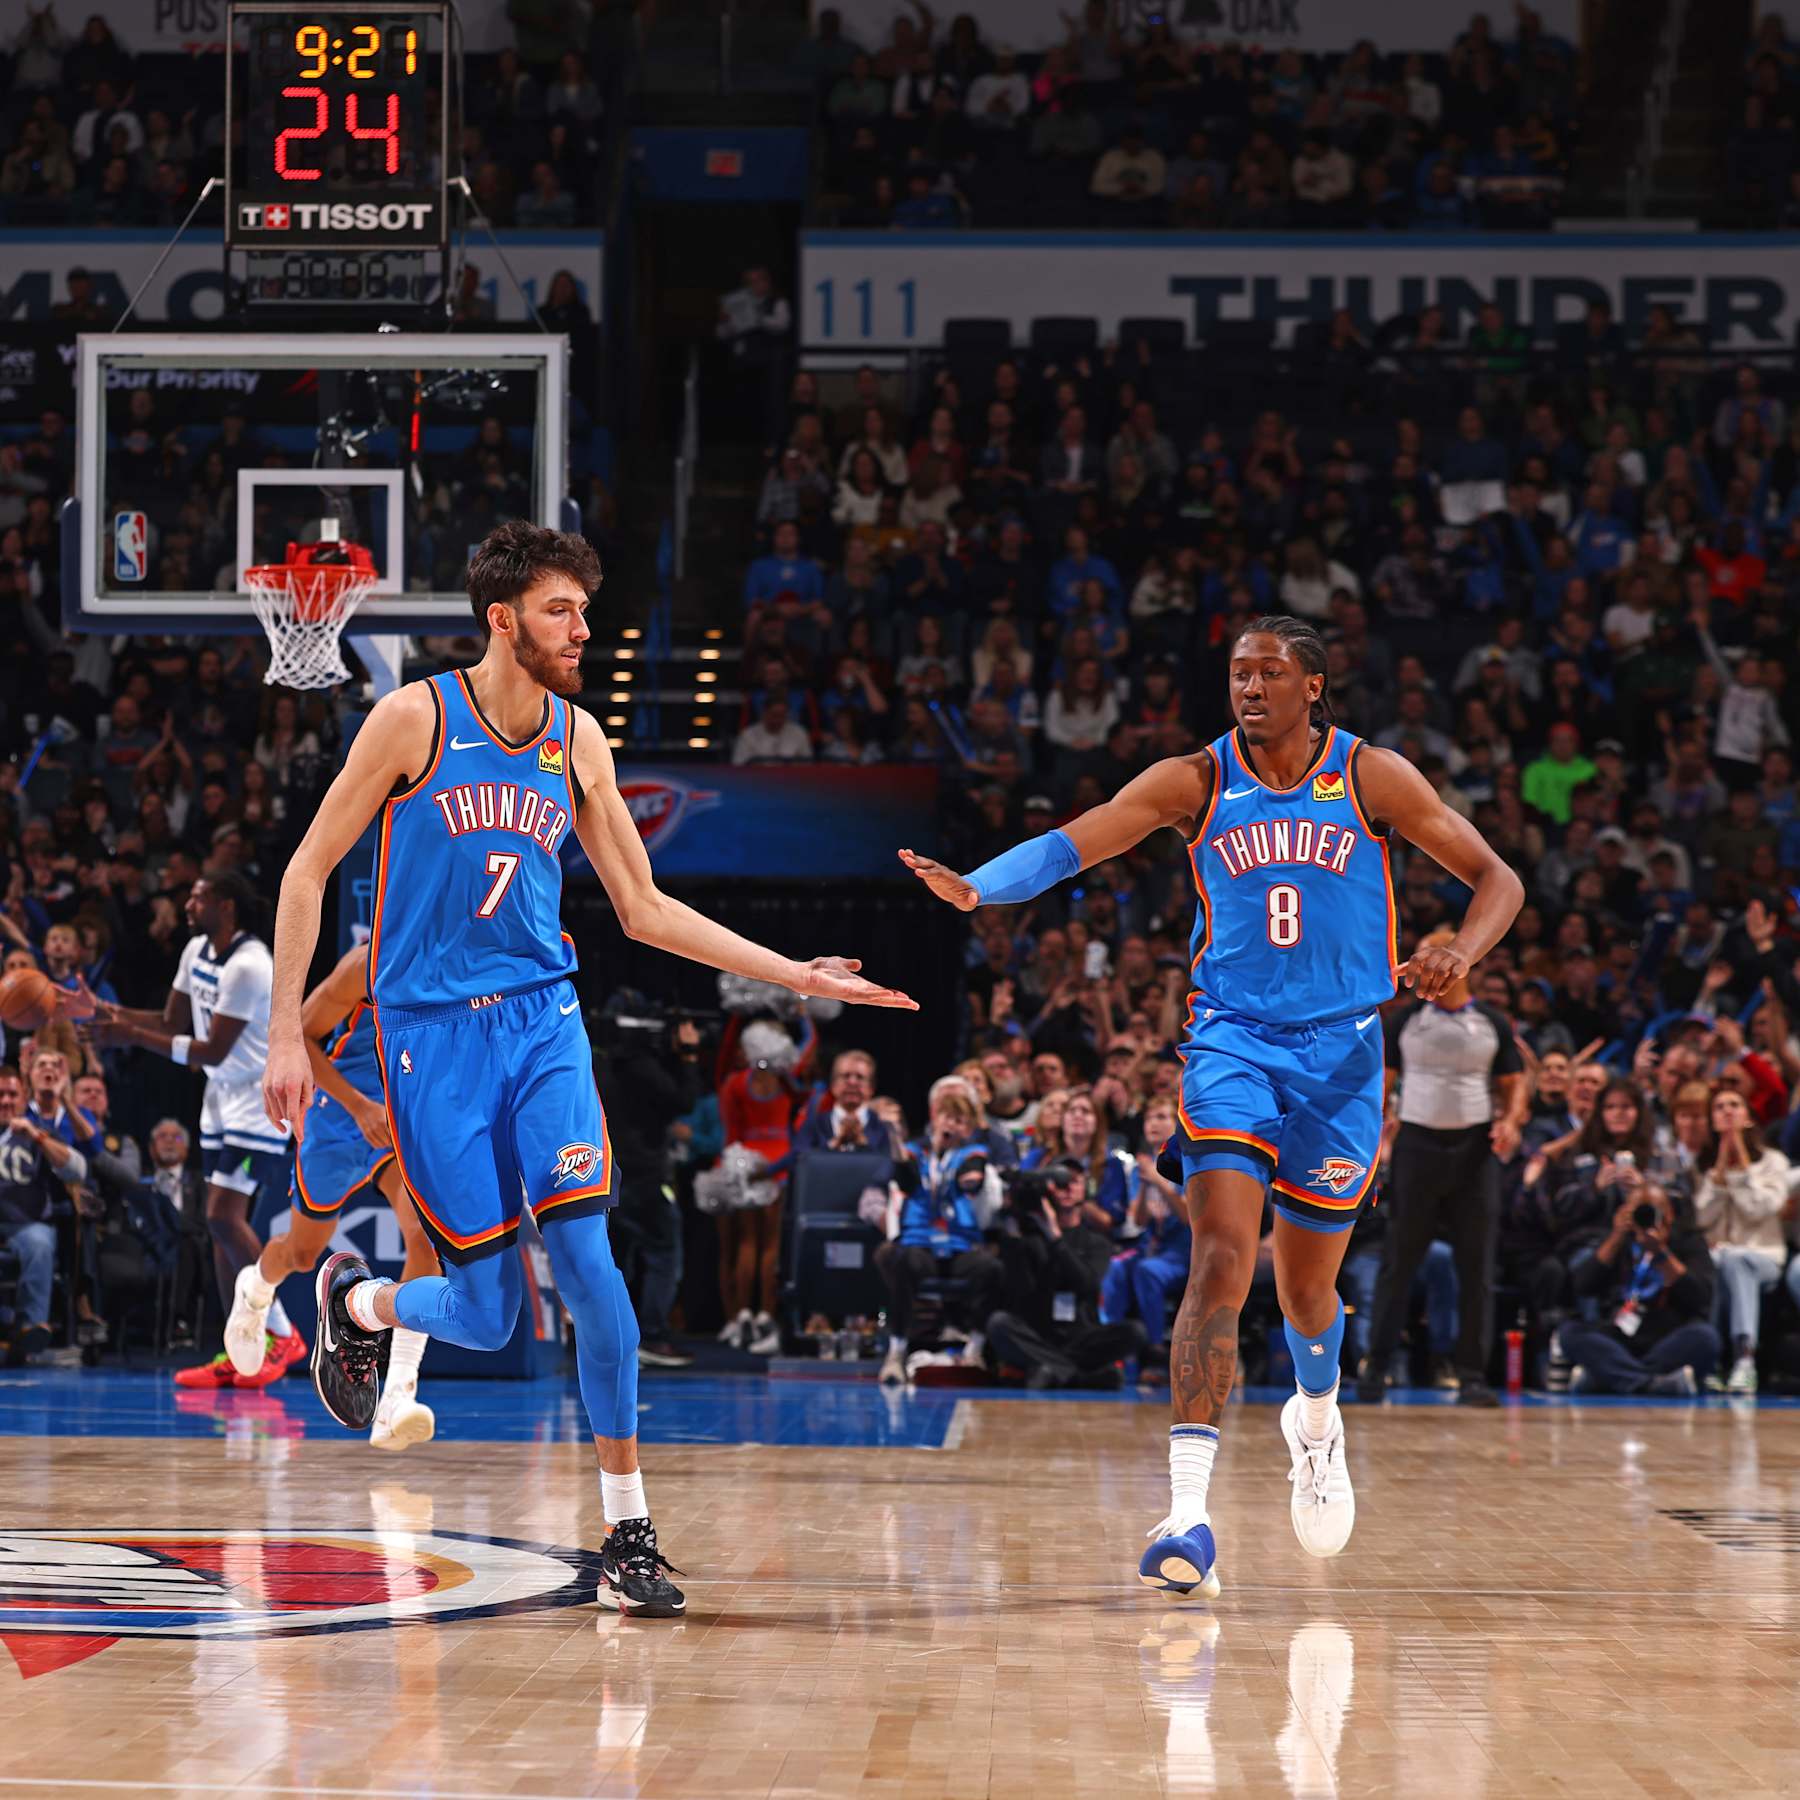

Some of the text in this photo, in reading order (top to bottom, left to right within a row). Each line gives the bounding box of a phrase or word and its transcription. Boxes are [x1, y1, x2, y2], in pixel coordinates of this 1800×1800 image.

[294, 24, 417, 79] 9:21
[273, 86, 400, 181] 24
[292, 203, 433, 230] TISSOT
[815, 278, 915, 337] 111
[1169, 275, 1786, 343] THUNDER
[433, 783, 567, 855] THUNDER
[1210, 819, 1357, 879] THUNDER
[476, 851, 521, 918] 7
[1267, 883, 1302, 948] 8
